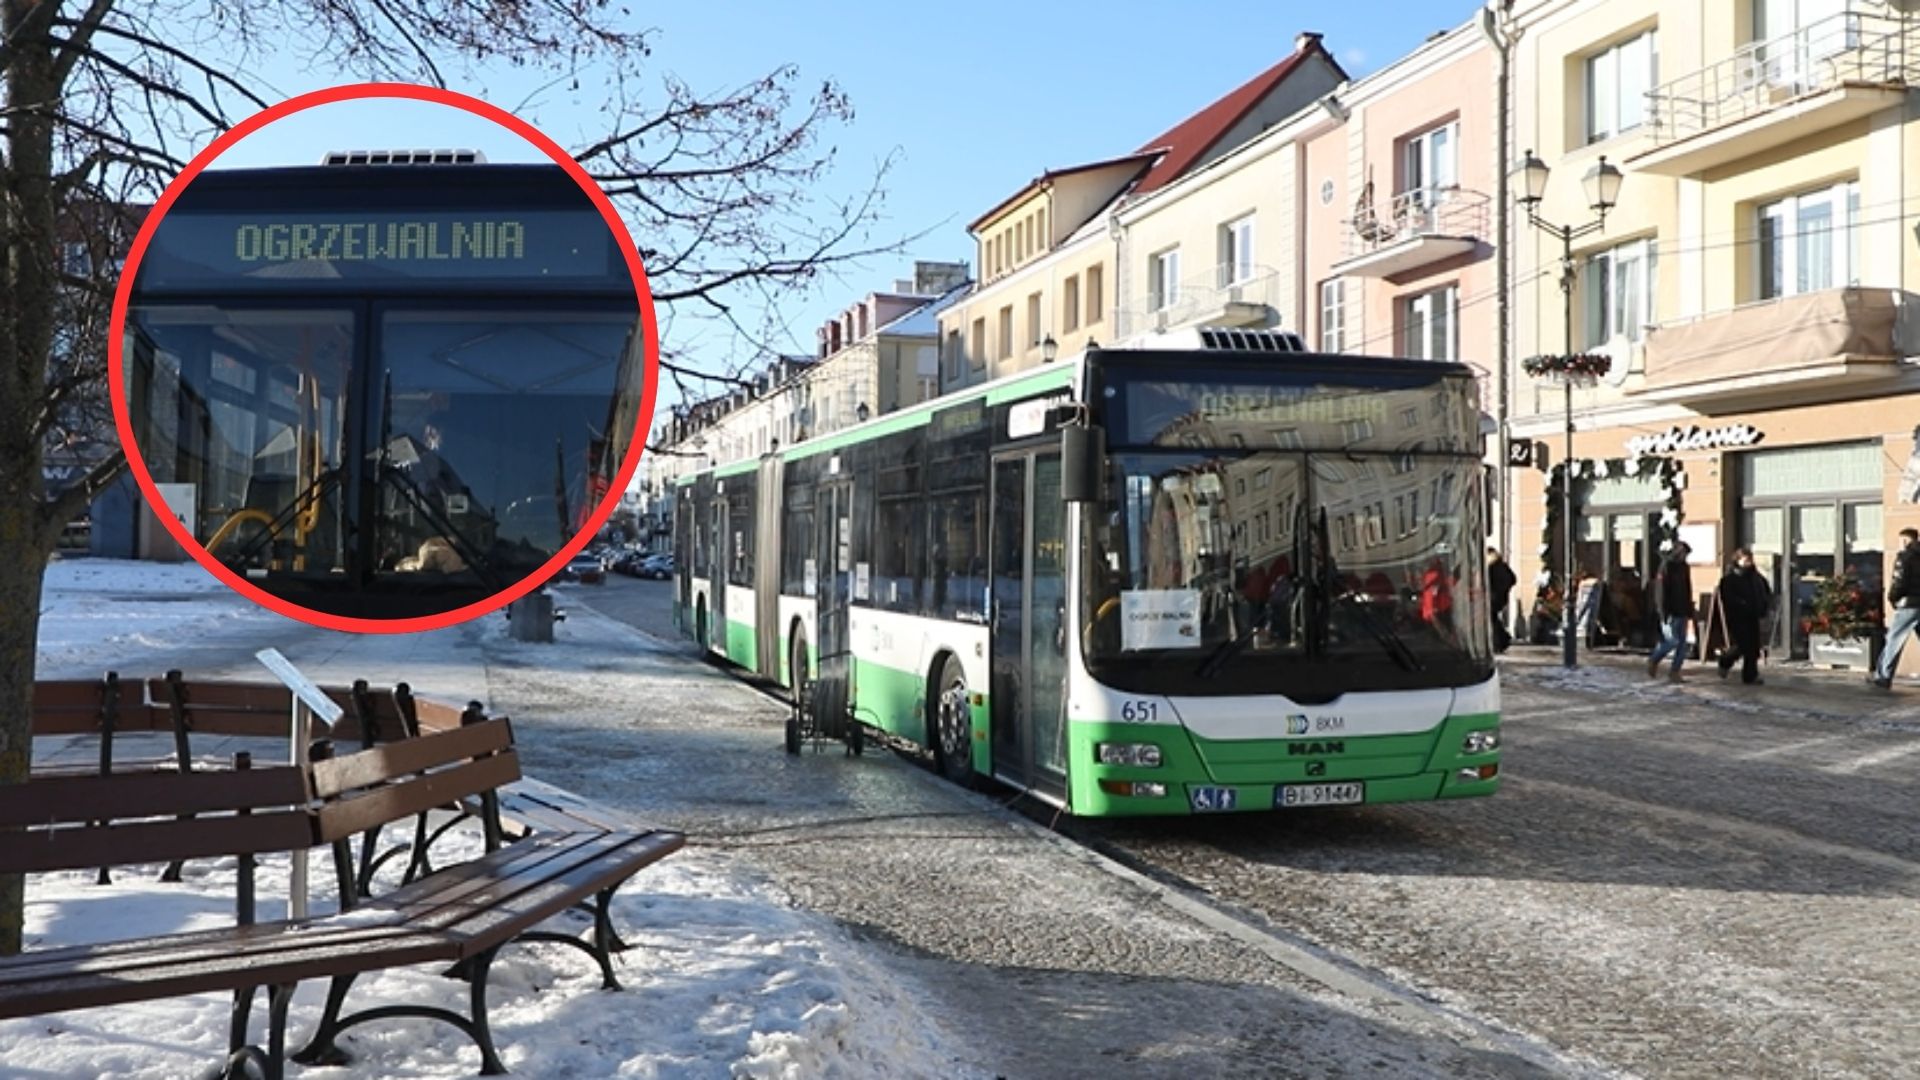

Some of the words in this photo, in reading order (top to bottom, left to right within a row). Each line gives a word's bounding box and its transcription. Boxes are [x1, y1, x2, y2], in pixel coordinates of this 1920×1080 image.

[236, 222, 524, 261] OGRZEWALNIA
[1122, 700, 1157, 722] 651
[1288, 741, 1345, 755] MAN
